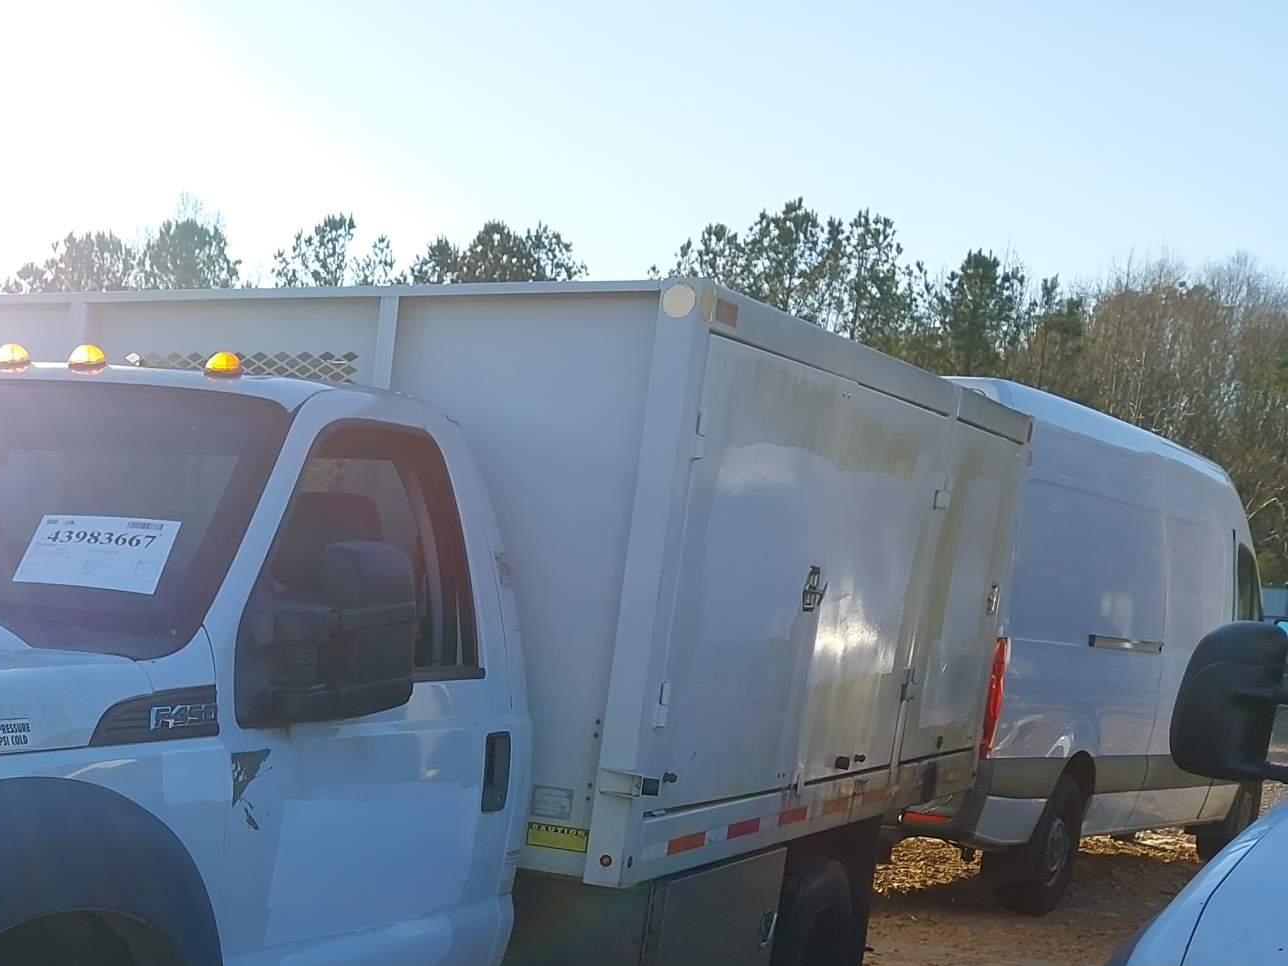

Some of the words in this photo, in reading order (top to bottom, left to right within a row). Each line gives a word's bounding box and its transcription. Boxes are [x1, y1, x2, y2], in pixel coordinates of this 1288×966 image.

[47, 529, 157, 549] 43983667
[11, 734, 29, 746] COLD
[532, 824, 586, 838] CAUTION
